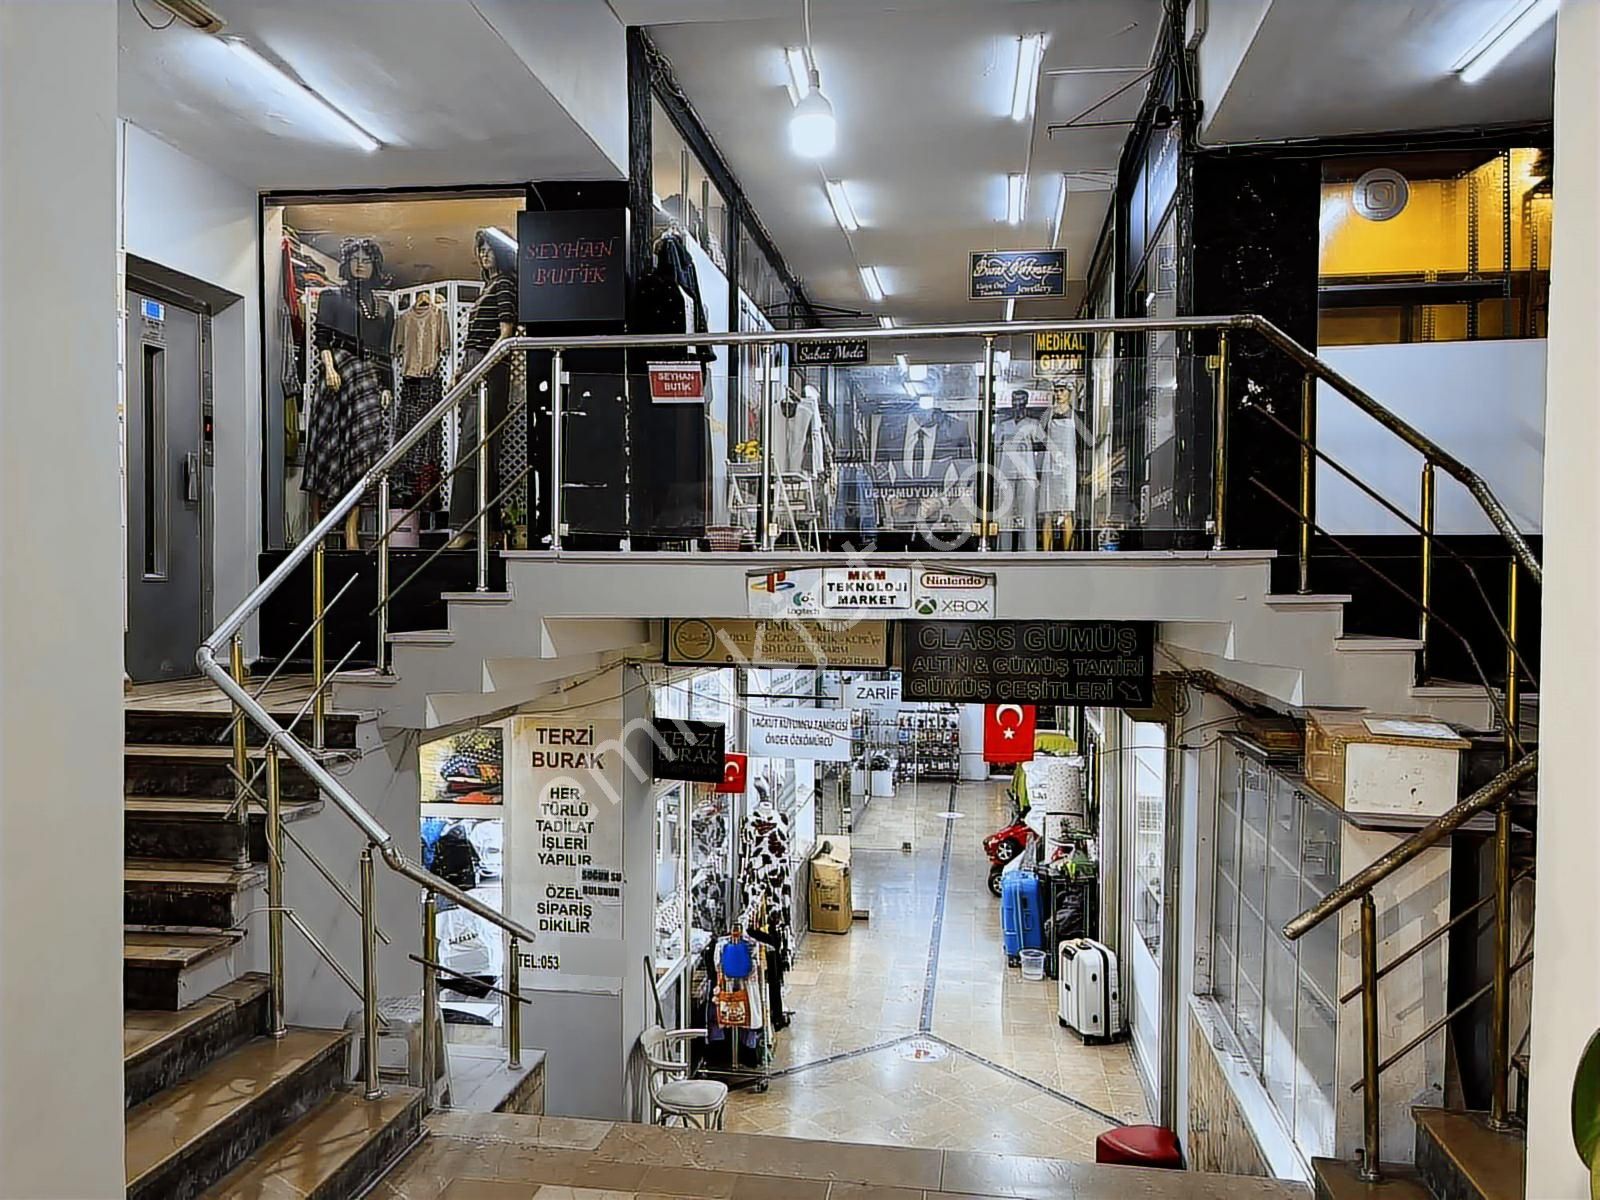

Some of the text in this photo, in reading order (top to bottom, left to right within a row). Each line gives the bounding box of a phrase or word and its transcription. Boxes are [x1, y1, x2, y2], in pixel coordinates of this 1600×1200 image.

[525, 238, 614, 260] SEYHAN
[657, 372, 695, 381] SEYHAN
[664, 381, 692, 391] BUTİK
[847, 570, 887, 581] MKM
[925, 576, 982, 586] Nintendo
[837, 595, 897, 605] MARKET
[942, 599, 989, 613] XBOX
[787, 608, 819, 616] Logitech
[918, 622, 1137, 656] CLASS GÜMÜŞ
[973, 657, 989, 674] &
[992, 654, 1070, 678] GÜMÜŞ
[1074, 655, 1144, 676] TAMİRİ
[856, 685, 900, 700] ZARİF
[910, 676, 1114, 701] GÜMÜŞ ÇEŞİTLERİ
[536, 725, 594, 746] TERZİ
[659, 729, 717, 748] TERZİ
[532, 751, 604, 770] BURAK
[658, 746, 719, 765] BURAK
[550, 787, 580, 800] HER
[541, 801, 589, 817] TÜRLÜ
[536, 818, 595, 834] TADİLAT
[542, 833, 588, 851] İŞLERİ
[538, 853, 592, 866] YAPILIR
[611, 872, 622, 882] SU
[545, 883, 583, 900] ÖZEL
[537, 901, 593, 920] SİPARİŞ
[539, 917, 590, 933] DİKİLİR
